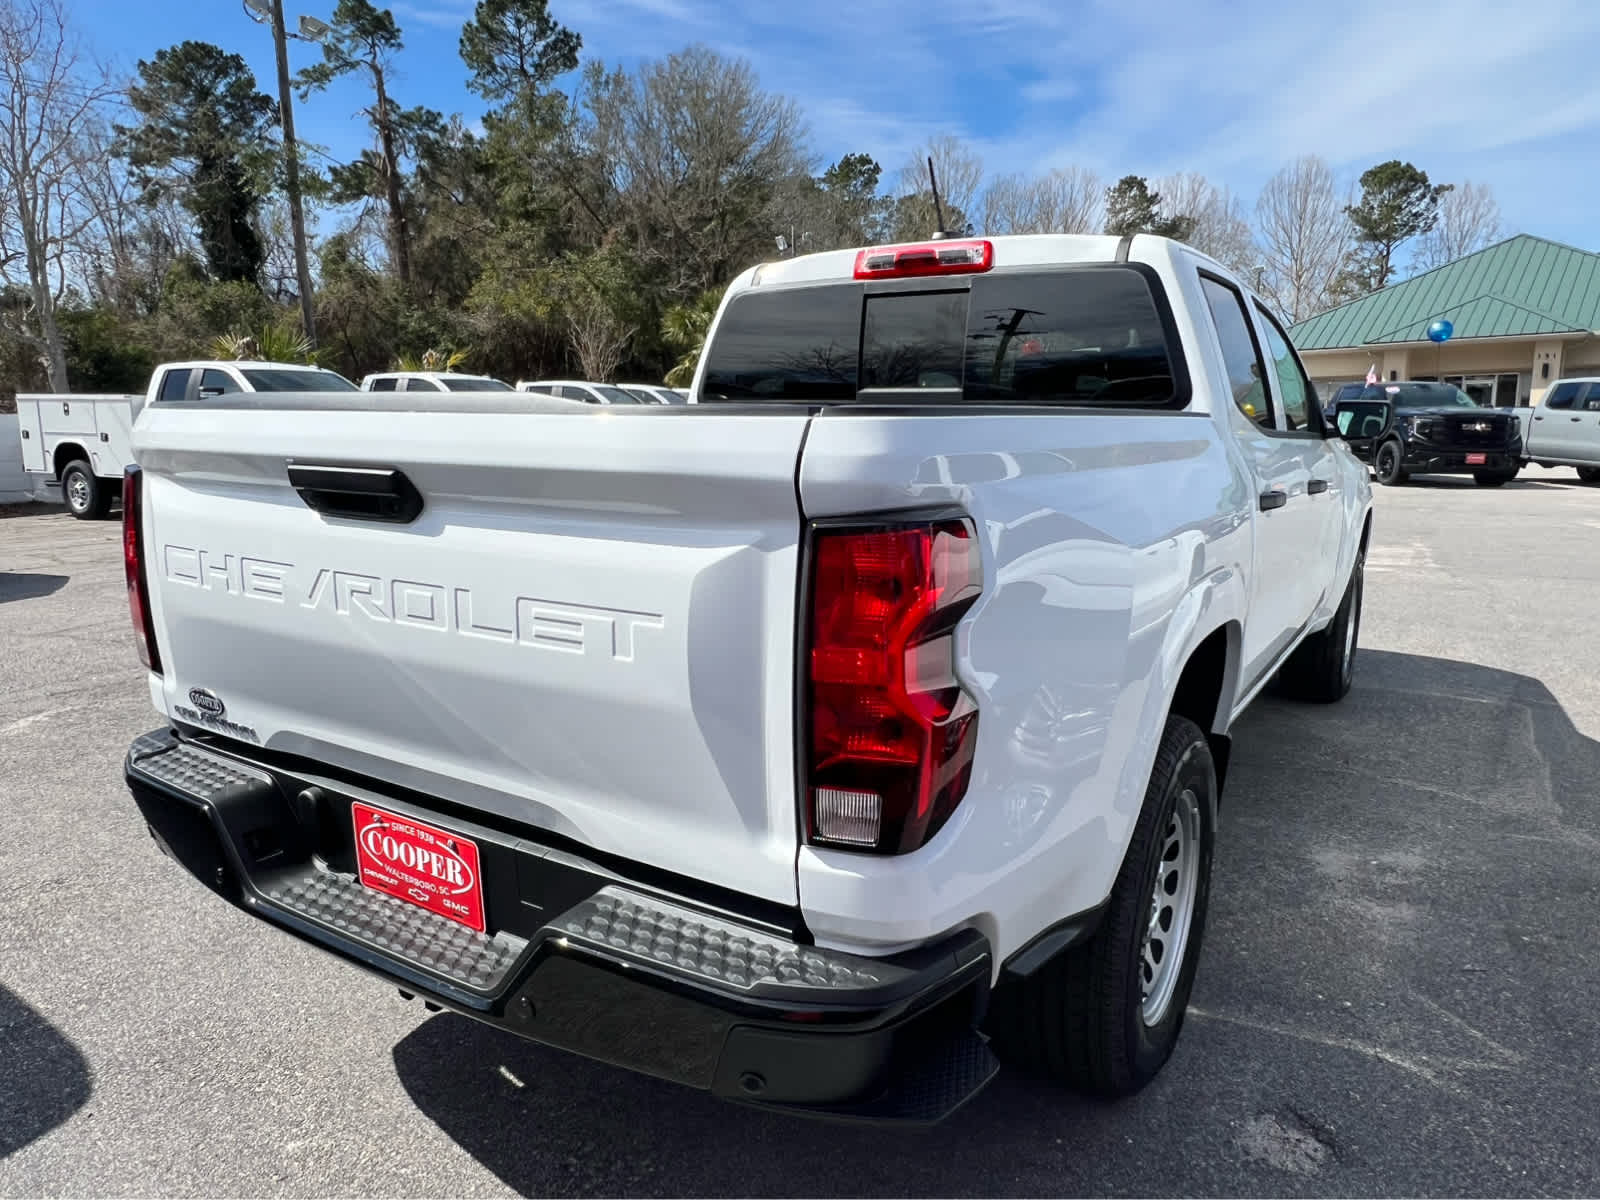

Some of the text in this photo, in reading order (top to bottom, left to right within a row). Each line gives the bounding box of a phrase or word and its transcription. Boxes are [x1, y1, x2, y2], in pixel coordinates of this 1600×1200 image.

[164, 544, 665, 663] CHEVROLET
[391, 822, 416, 836] SINCE
[367, 830, 465, 887] COOPER
[442, 898, 470, 915] GMC
